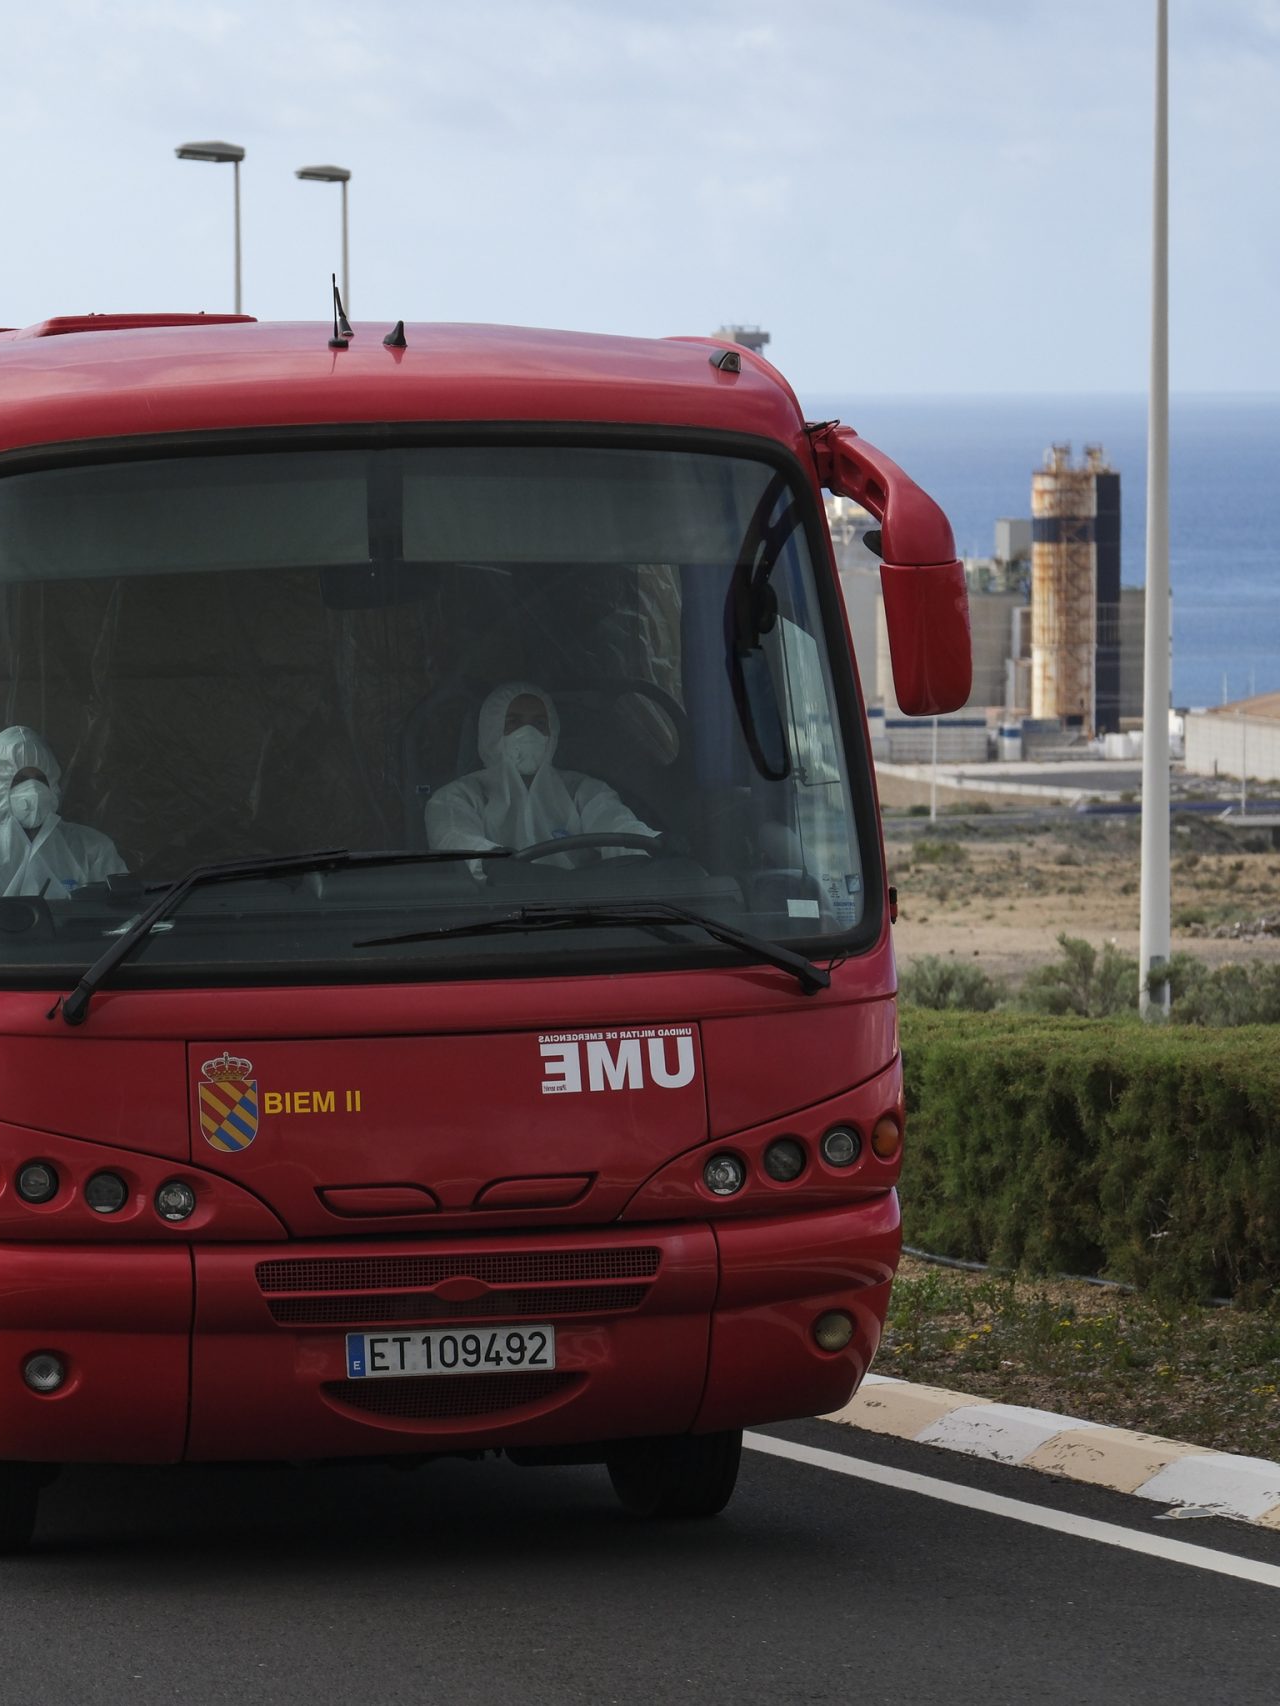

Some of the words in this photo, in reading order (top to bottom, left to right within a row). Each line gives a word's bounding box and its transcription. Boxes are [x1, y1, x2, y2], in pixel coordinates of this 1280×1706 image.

[264, 1091, 335, 1114] BIEM
[346, 1090, 361, 1112] II
[353, 1361, 361, 1370] E
